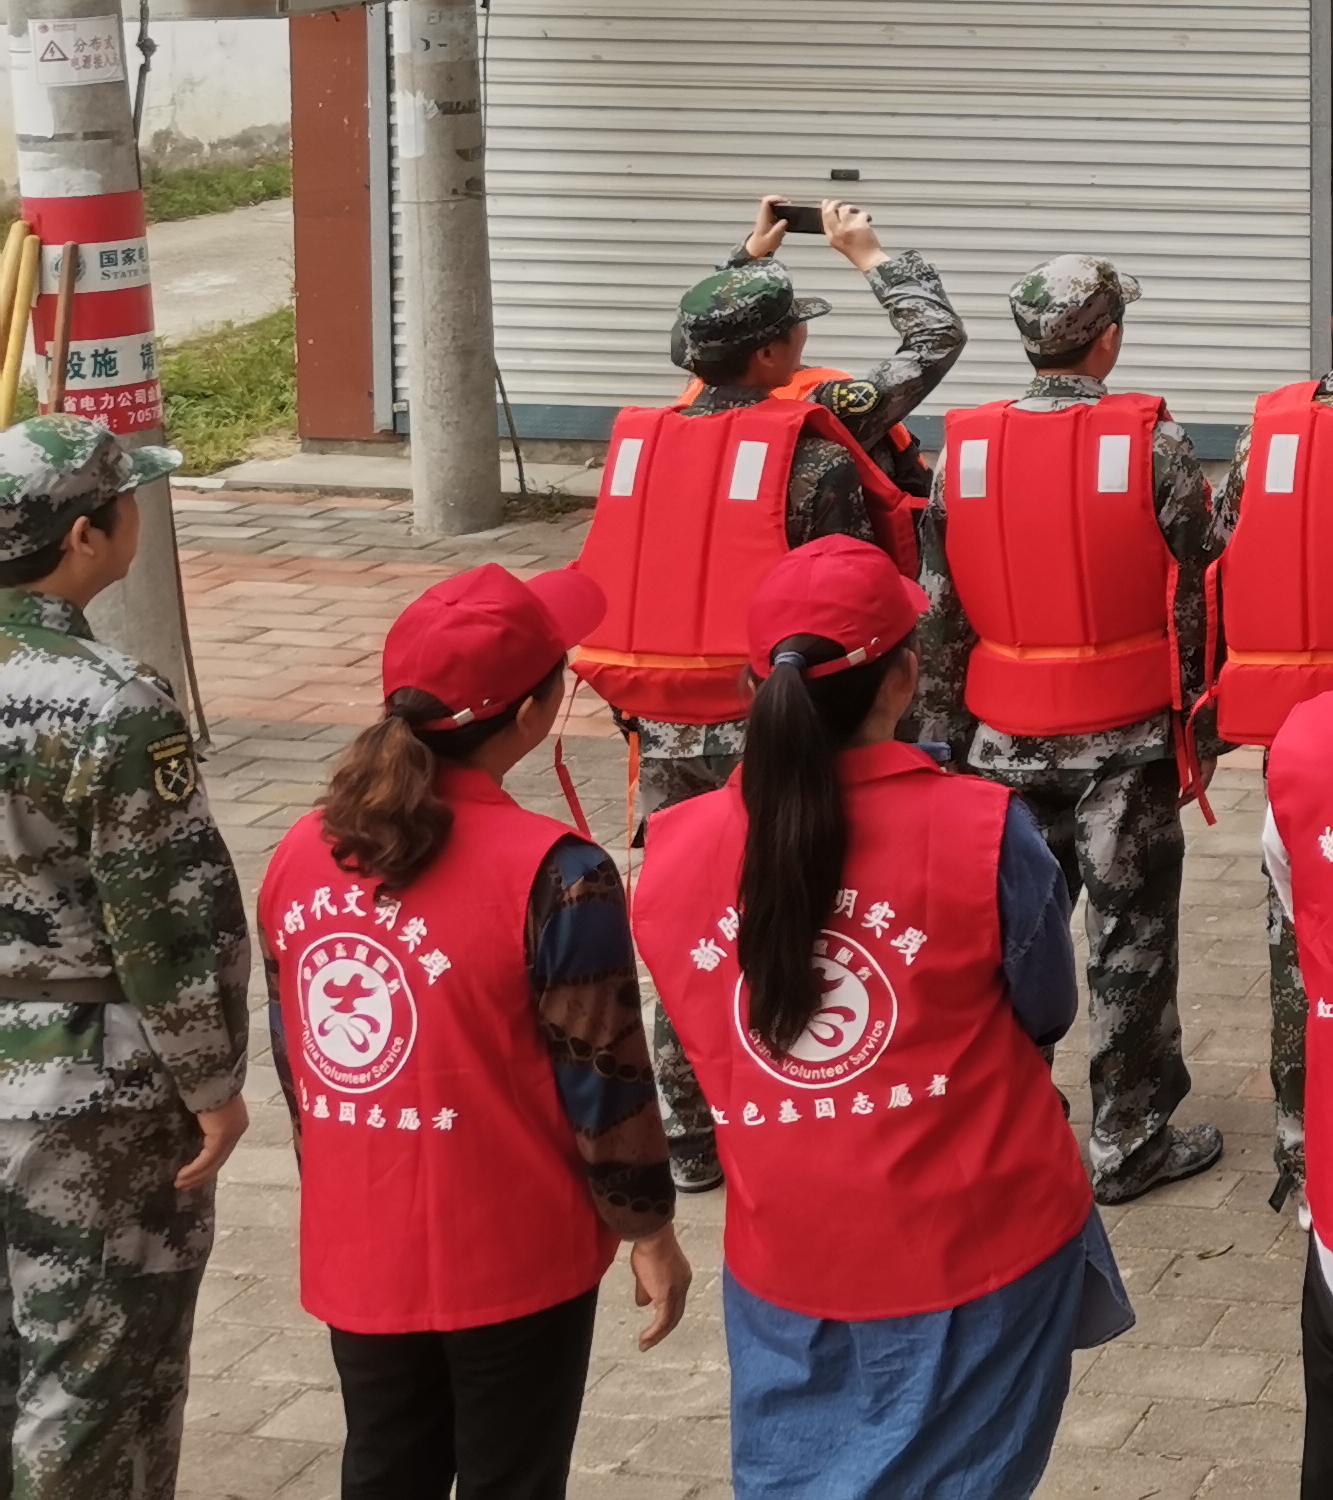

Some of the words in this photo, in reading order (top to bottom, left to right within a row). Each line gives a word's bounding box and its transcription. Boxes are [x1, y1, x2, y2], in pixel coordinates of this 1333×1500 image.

[319, 1056, 372, 1085] Volunteer
[371, 1036, 405, 1079] Service
[781, 1058, 850, 1081] Volunteer
[848, 1019, 886, 1067] Service
